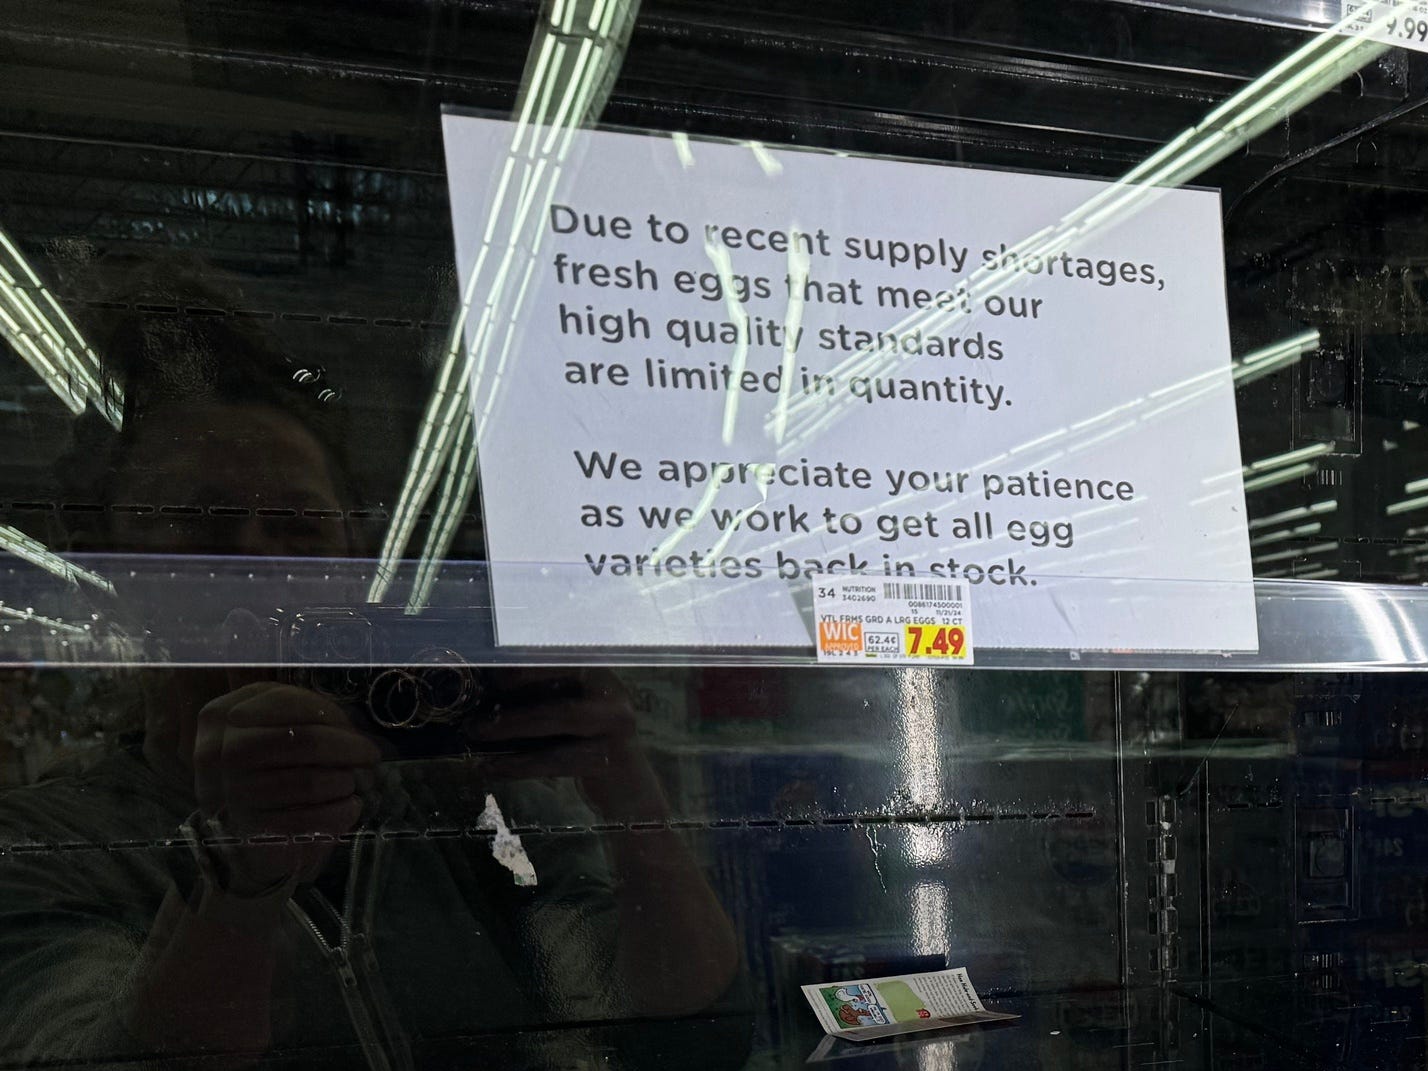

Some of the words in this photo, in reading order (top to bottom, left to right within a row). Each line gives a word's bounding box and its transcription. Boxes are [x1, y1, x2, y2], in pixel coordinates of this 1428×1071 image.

[550, 204, 632, 240] Due
[647, 214, 690, 244] to
[704, 224, 831, 256] recent
[844, 236, 968, 273] supply
[981, 243, 1166, 291] shortages,
[554, 253, 659, 291] fresh
[674, 269, 772, 303] eggs
[785, 272, 864, 305] that
[877, 287, 972, 313] meet
[984, 294, 1043, 319] our
[559, 303, 650, 343] high
[666, 315, 804, 354] quality
[818, 323, 1004, 361] standards
[564, 360, 629, 386] are
[646, 358, 783, 393] limited
[801, 366, 834, 396] in
[849, 374, 1012, 411] quantity.
[573, 450, 643, 481] We
[658, 457, 872, 490] appreciate
[885, 468, 969, 497] your
[983, 470, 1135, 502] patience
[580, 503, 624, 528] as
[638, 504, 696, 530] we
[710, 503, 809, 533] work
[822, 507, 862, 535] to
[876, 511, 940, 542] get
[952, 511, 993, 540] all
[1006, 519, 1074, 549] egg
[584, 547, 763, 579] varieties
[776, 550, 868, 580] back
[883, 553, 916, 578] in
[930, 557, 1038, 586] stock.
[818, 587, 836, 598] 34
[823, 624, 859, 641] WIC
[865, 616, 883, 624] GRD
[914, 617, 936, 625] EGGS
[942, 617, 950, 625] 12
[868, 636, 896, 645] 62.4¢
[908, 626, 965, 655] 7.49
